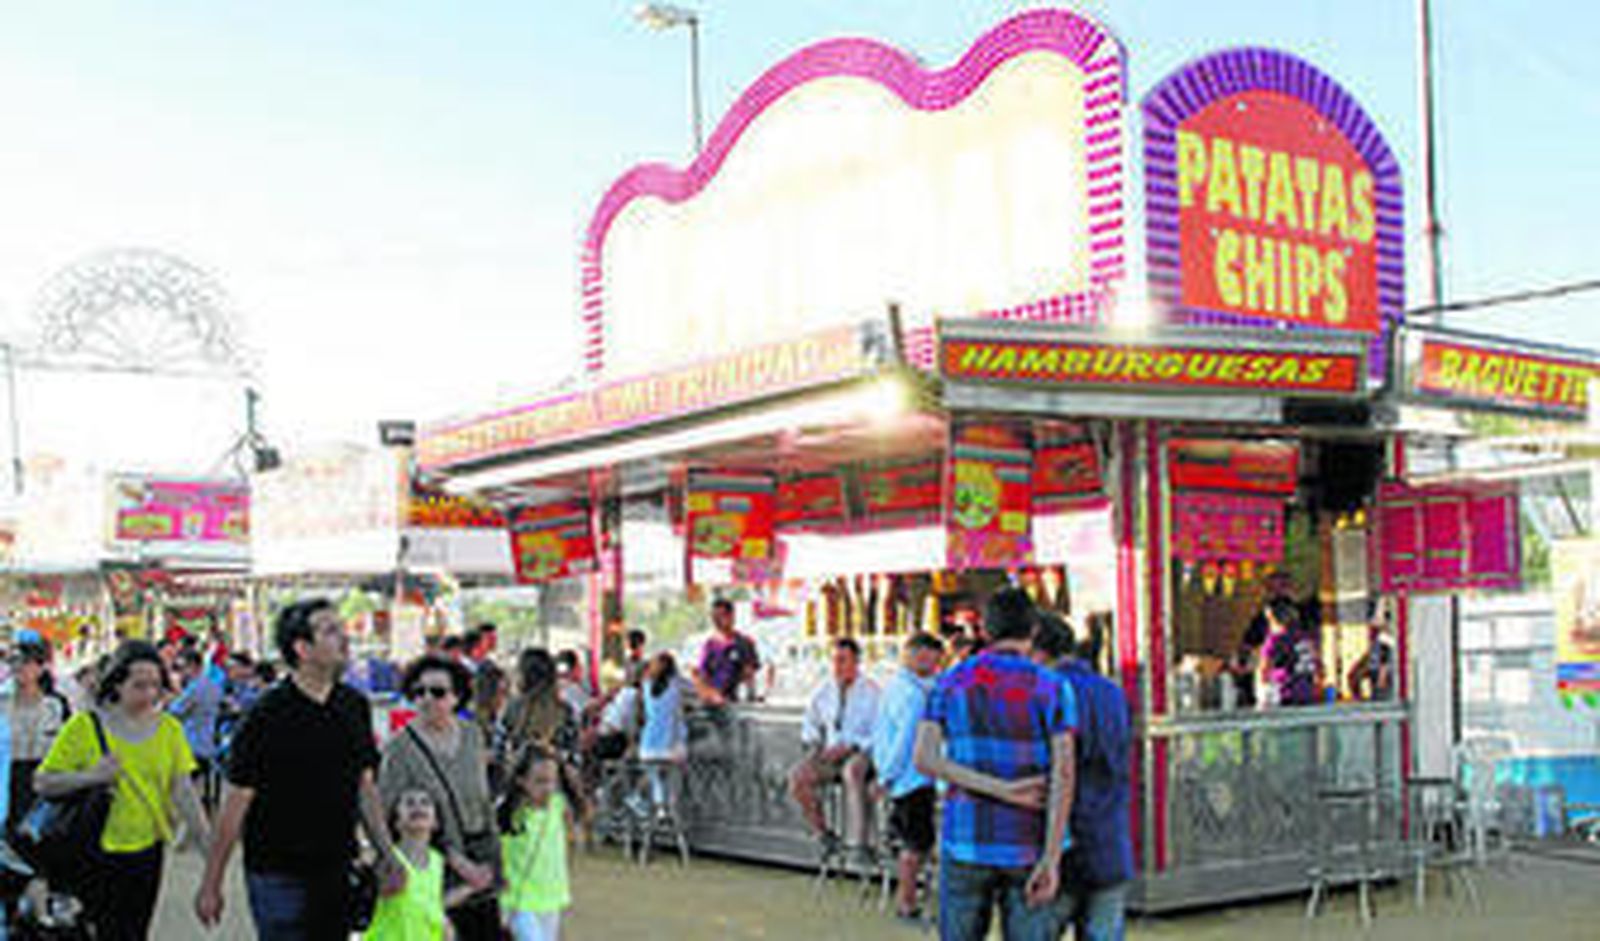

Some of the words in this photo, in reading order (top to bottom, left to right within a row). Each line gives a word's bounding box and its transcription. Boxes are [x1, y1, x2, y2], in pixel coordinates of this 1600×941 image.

[1177, 130, 1375, 243] PATATAS
[1216, 228, 1348, 323] CHIPS
[959, 344, 1332, 383] HAMBURGUESAS
